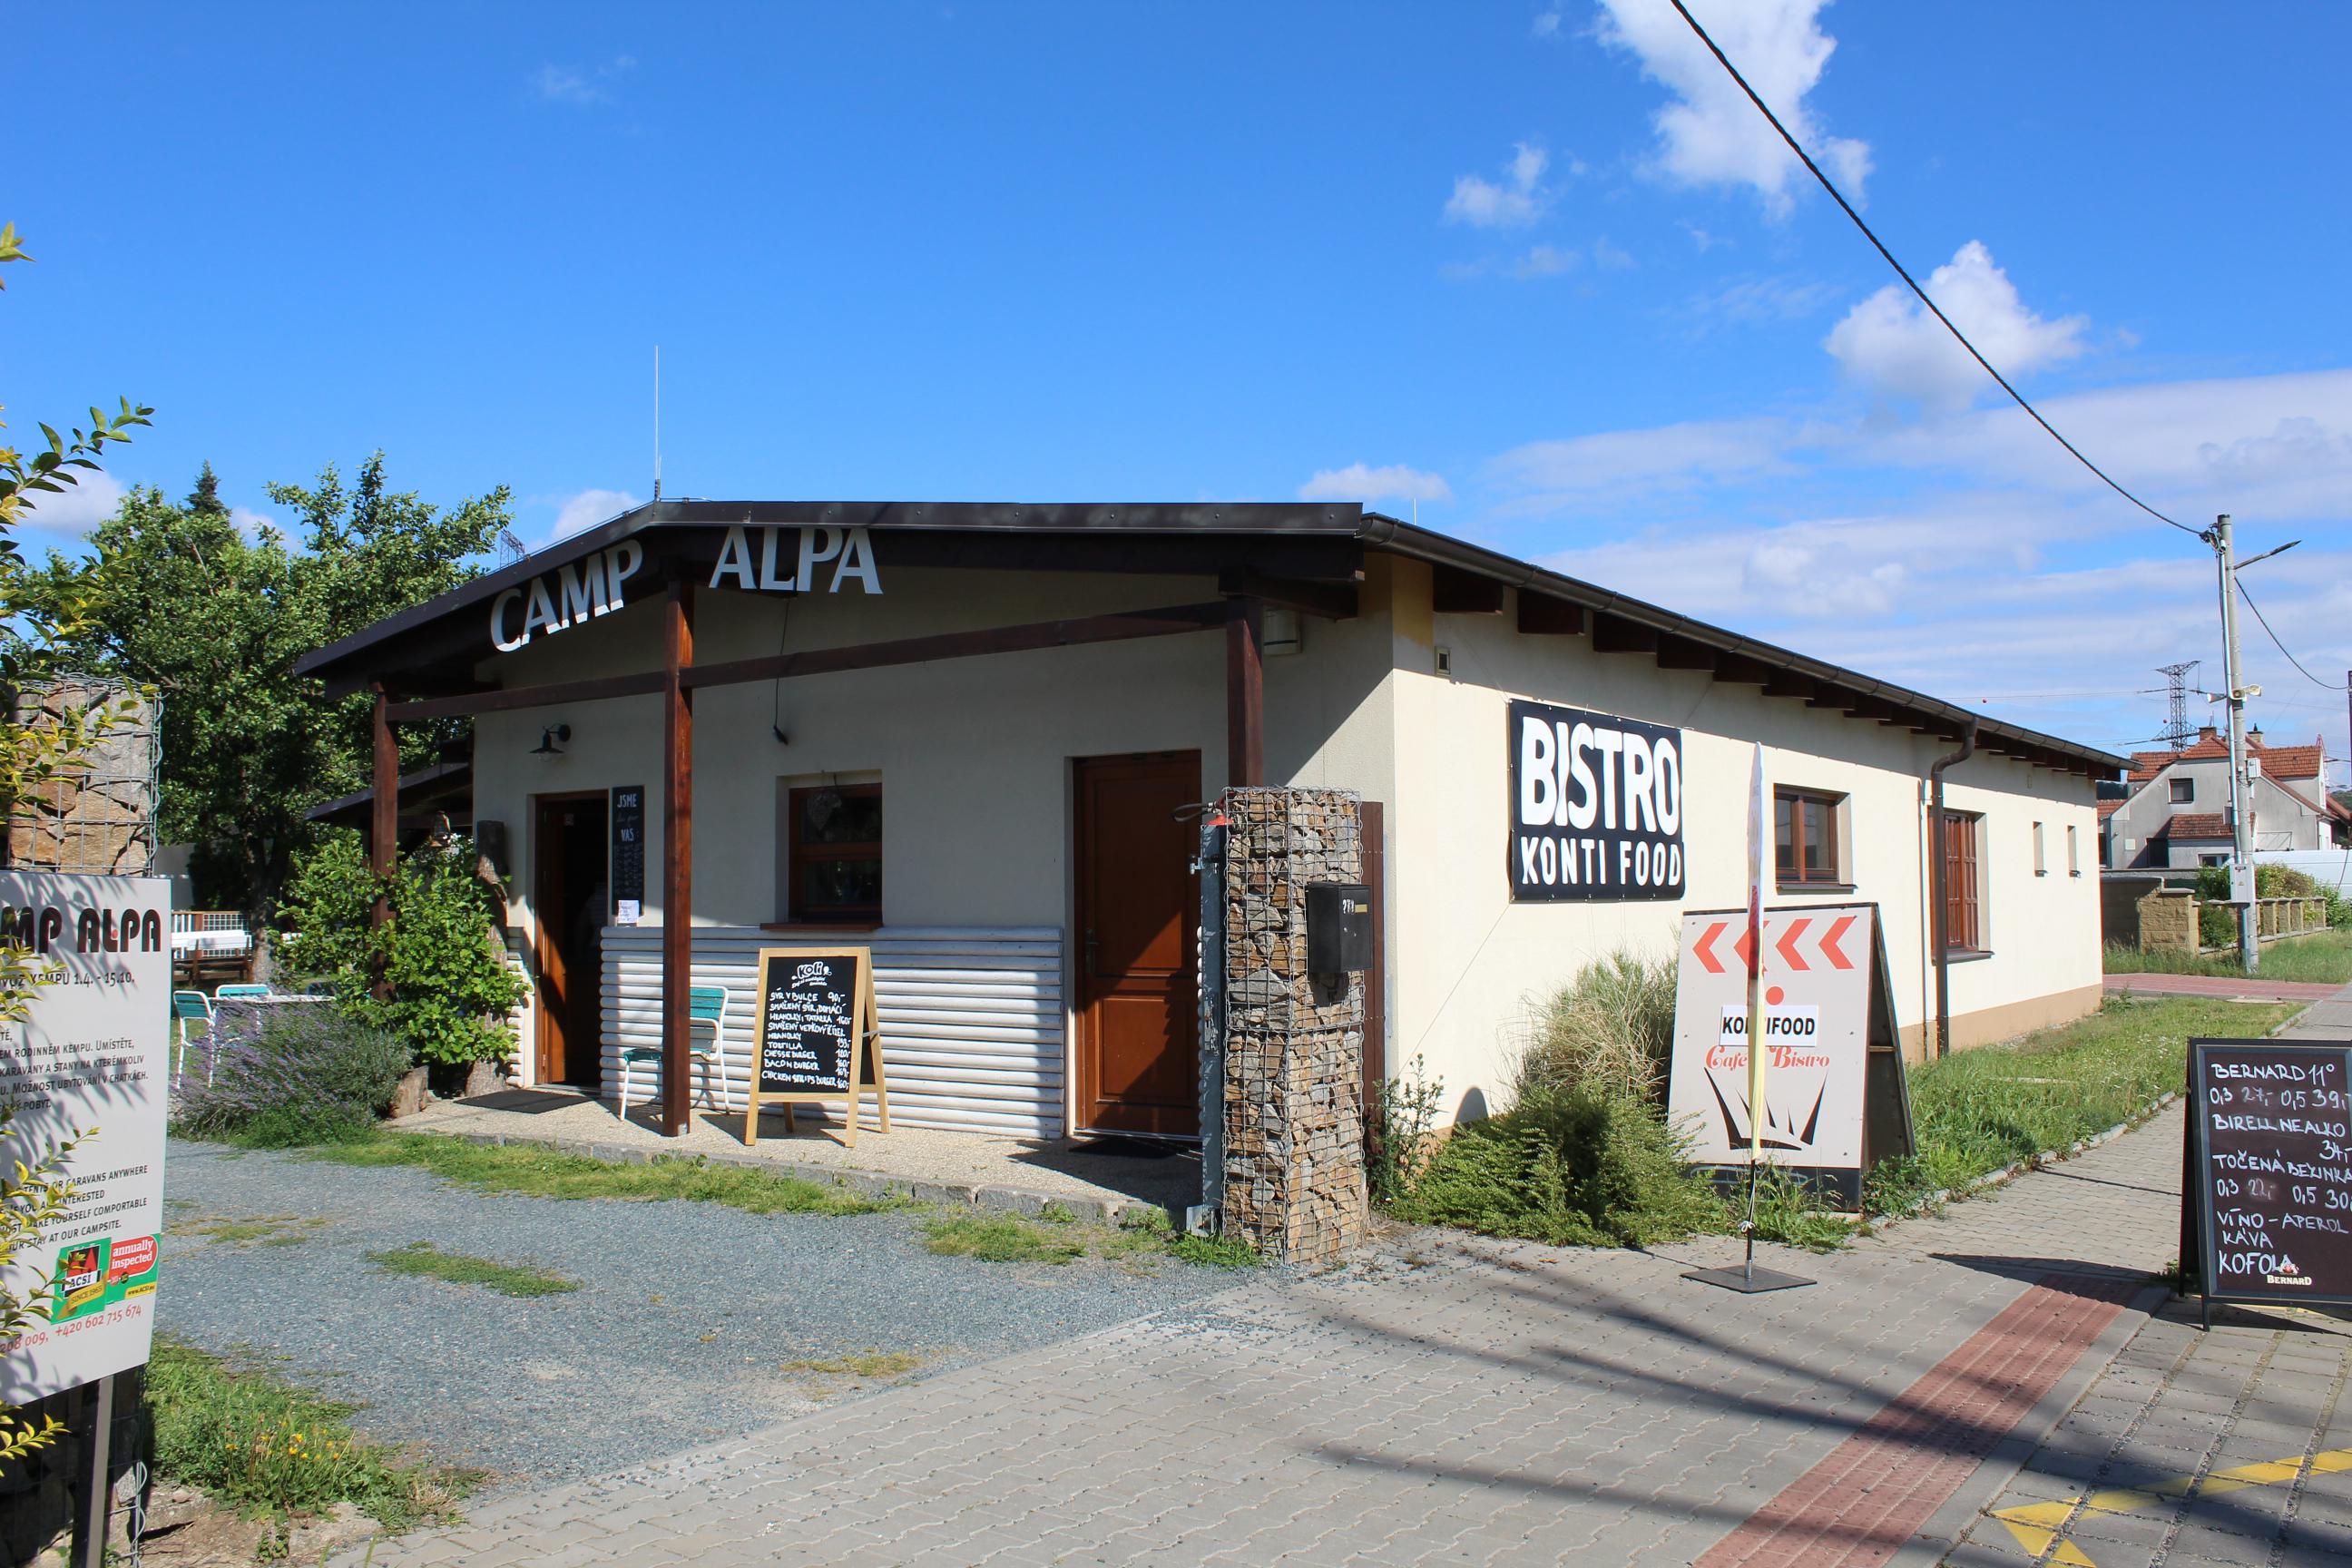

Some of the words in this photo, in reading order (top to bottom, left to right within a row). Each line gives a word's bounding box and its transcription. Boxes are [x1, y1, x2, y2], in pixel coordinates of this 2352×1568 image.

[490, 539, 642, 652] CAMP
[709, 526, 884, 595] ALPA
[1521, 716, 1680, 836] BISTRO
[617, 794, 637, 808] JSME
[1521, 837, 1606, 885] KONTI
[1620, 840, 1681, 887] FOOD
[77, 908, 162, 953] ALPA
[74, 972, 93, 987] 1.4.
[104, 971, 134, 987] 15.10.
[1722, 1016, 1815, 1035] KOIFOOD
[15, 1043, 60, 1058] RODINNÉM
[63, 1042, 93, 1054] KEMPU.
[767, 1042, 803, 1050] TORTILLA
[45, 1064, 51, 1073] A
[54, 1062, 78, 1073] STANY
[80, 1059, 91, 1069] NA
[93, 1054, 145, 1068] KTERÉMKOLIV
[764, 1058, 792, 1068] BACON
[793, 1061, 820, 1071] BURGER
[1769, 1045, 1829, 1069] Bistro
[57, 1073, 101, 1089] UBYTOVÁNÍ
[109, 1070, 149, 1083] CHATKÁCH.
[761, 1070, 791, 1082] CHICKEN
[2210, 1063, 2306, 1082] BERNARD
[2210, 1087, 2233, 1105] 0,3
[2280, 1090, 2307, 1111] 0,5
[2211, 1113, 2278, 1132] BIRELL
[2278, 1117, 2346, 1138] NEALKO
[2211, 1148, 2286, 1173] TOČENÁ
[65, 1172, 107, 1187] CARAVANS
[107, 1164, 148, 1180] ANYWHERE
[59, 1190, 105, 1206] INTERESTED
[2216, 1178, 2239, 1197] 0,3
[2292, 1184, 2317, 1205] 0,5
[51, 1209, 92, 1226] YOURSELF
[2217, 1208, 2264, 1229] VÍNO
[2282, 1212, 2349, 1234] APEROL
[49, 1232, 59, 1243] AT
[61, 1228, 79, 1240] OUR
[81, 1220, 122, 1236] CAMPSITE.
[2222, 1227, 2274, 1249] KÁVA
[113, 1239, 154, 1258] annually
[112, 1250, 152, 1269] inspected
[2218, 1250, 2294, 1275] KOFOLA
[69, 1274, 92, 1289] ACSI
[24, 1331, 49, 1347] 009,
[55, 1321, 83, 1338] +420
[85, 1315, 104, 1328] 602
[107, 1308, 123, 1326] 715
[125, 1304, 142, 1319] 674
